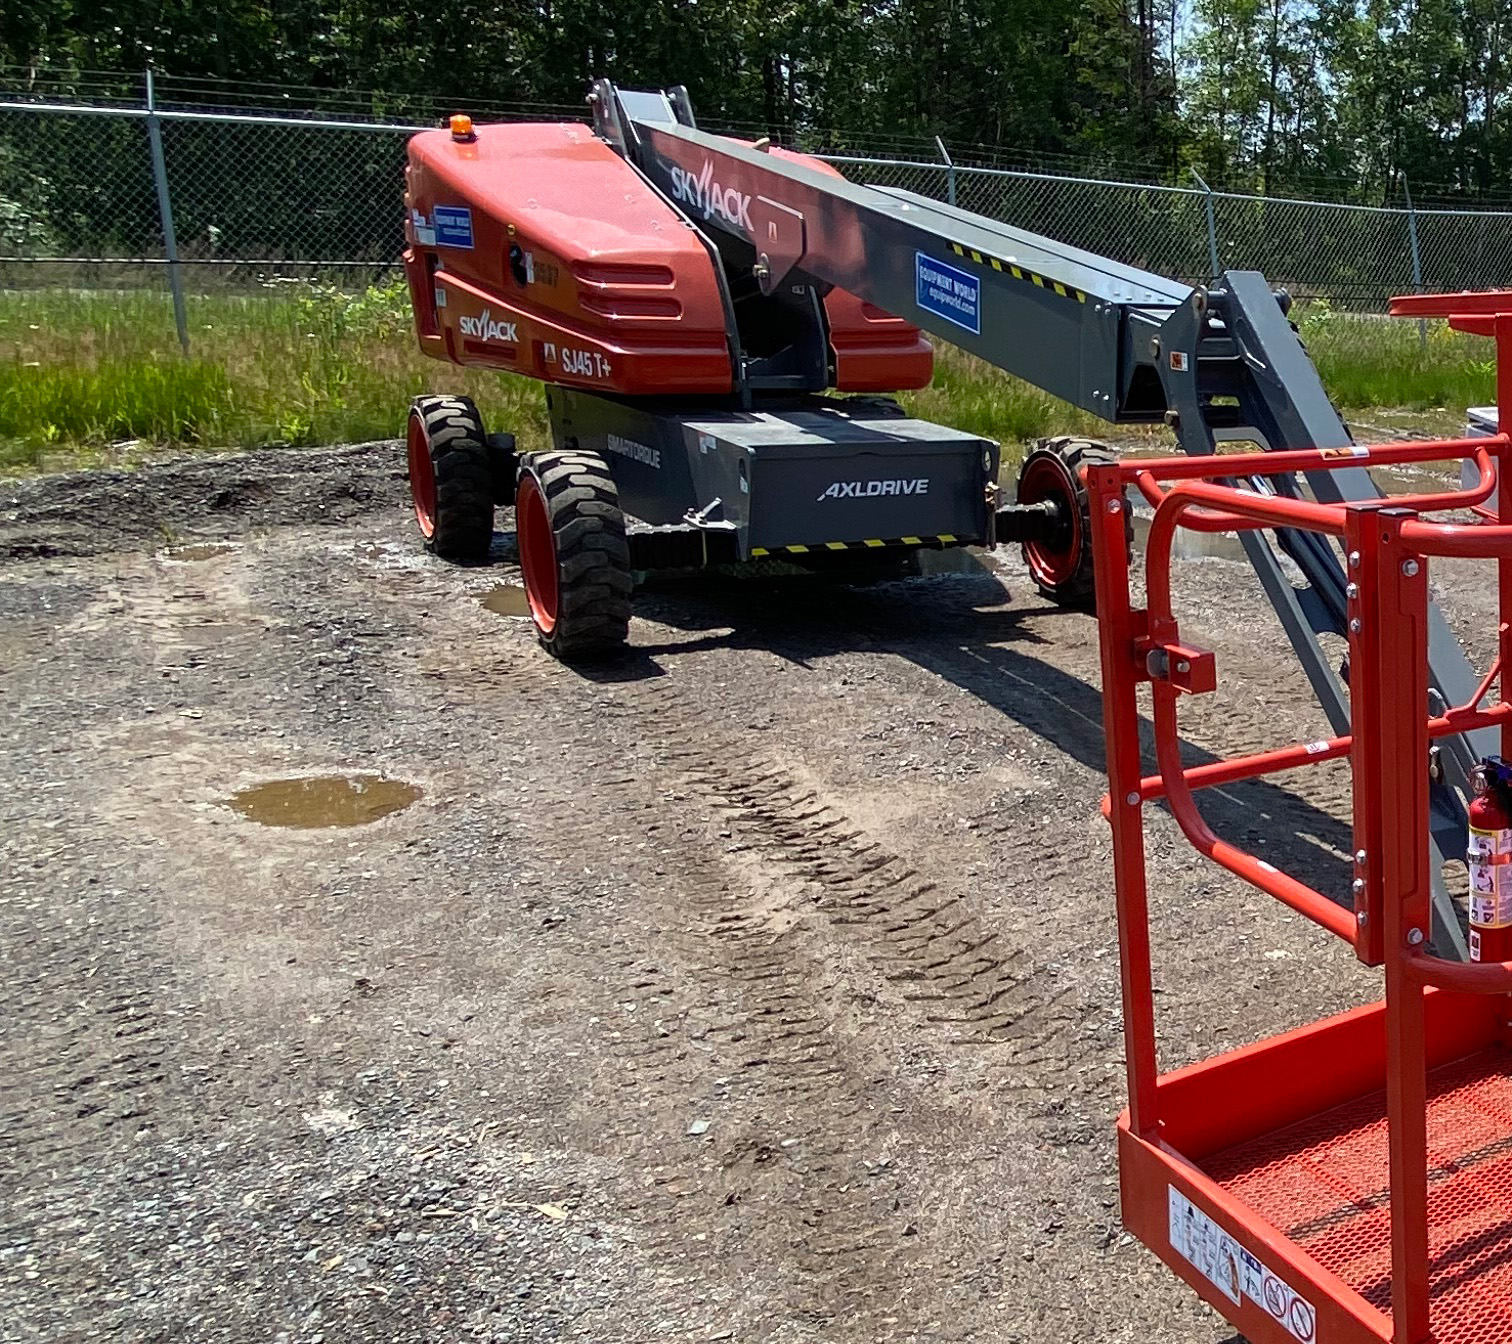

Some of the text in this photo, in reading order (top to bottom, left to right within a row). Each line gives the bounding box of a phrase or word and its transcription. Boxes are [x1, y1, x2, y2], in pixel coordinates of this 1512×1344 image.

[671, 158, 755, 232] SKYJACK
[459, 309, 519, 343] SKYJACK
[562, 348, 612, 377] SJ45 T+
[816, 479, 930, 502] AXLDRIVE
